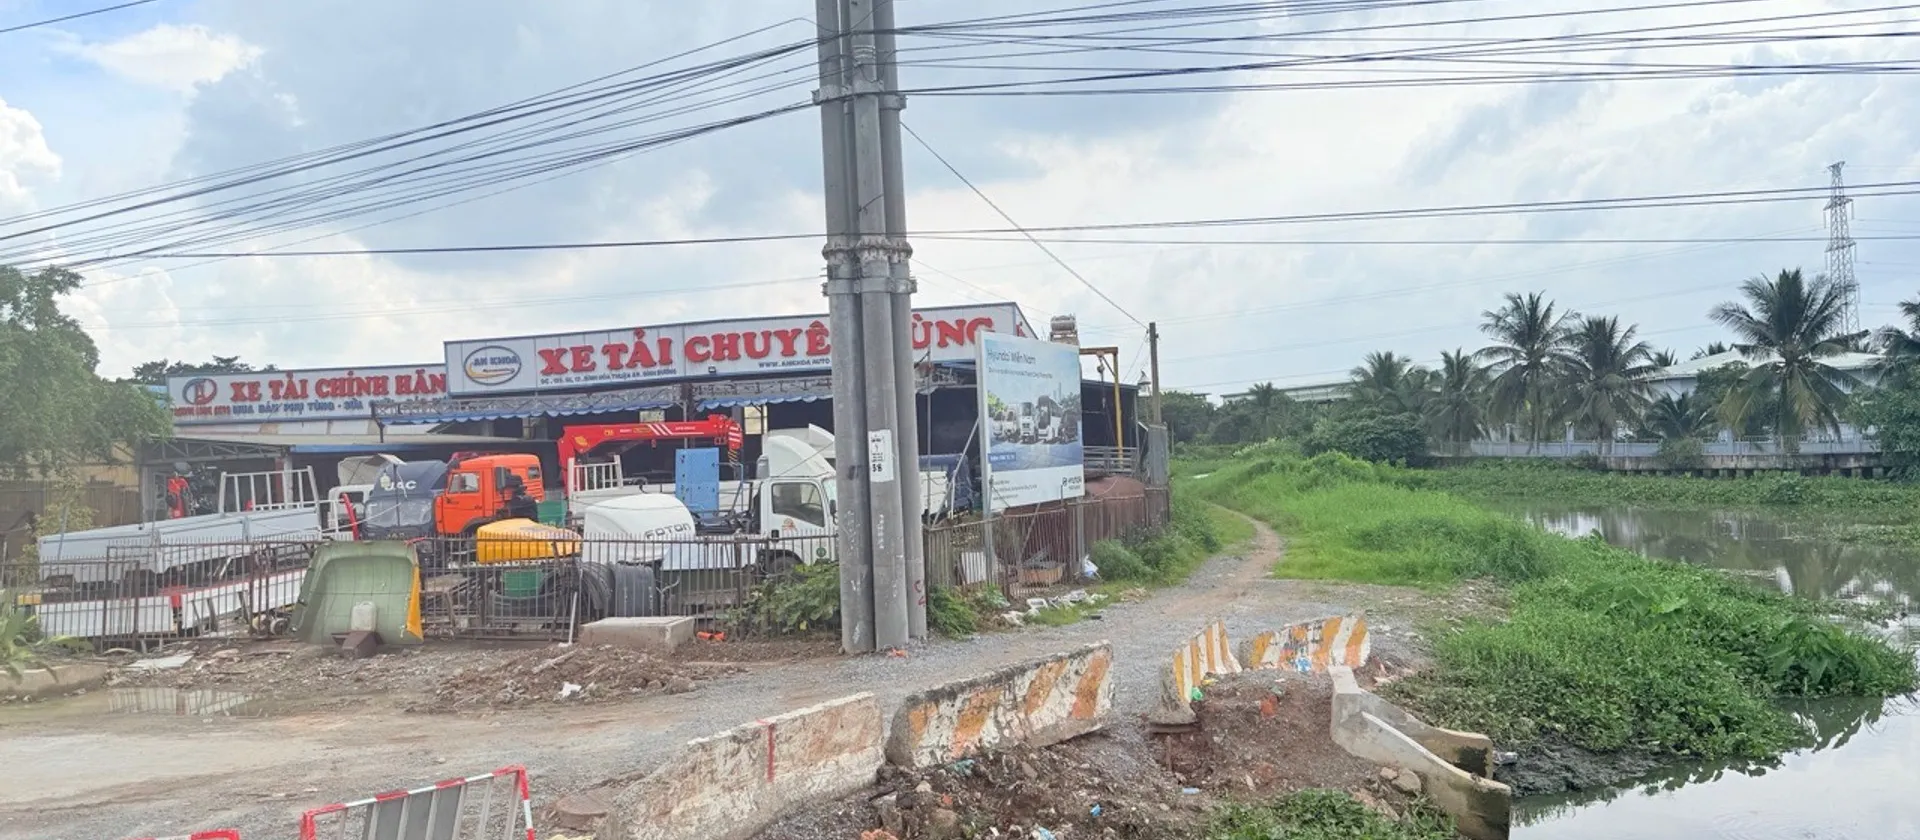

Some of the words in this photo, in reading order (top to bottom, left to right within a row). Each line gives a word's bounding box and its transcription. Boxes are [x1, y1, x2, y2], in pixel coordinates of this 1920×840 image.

[538, 345, 597, 376] XE
[601, 327, 673, 371] TẢI
[684, 320, 831, 362] CHUYÊ
[473, 356, 489, 366] AN
[490, 355, 519, 366] KHOA
[230, 381, 262, 402] XE
[268, 370, 309, 400] TẢI
[315, 370, 390, 398] CHÍNH
[307, 399, 335, 411] TÙNG
[644, 523, 691, 540] FOTON
